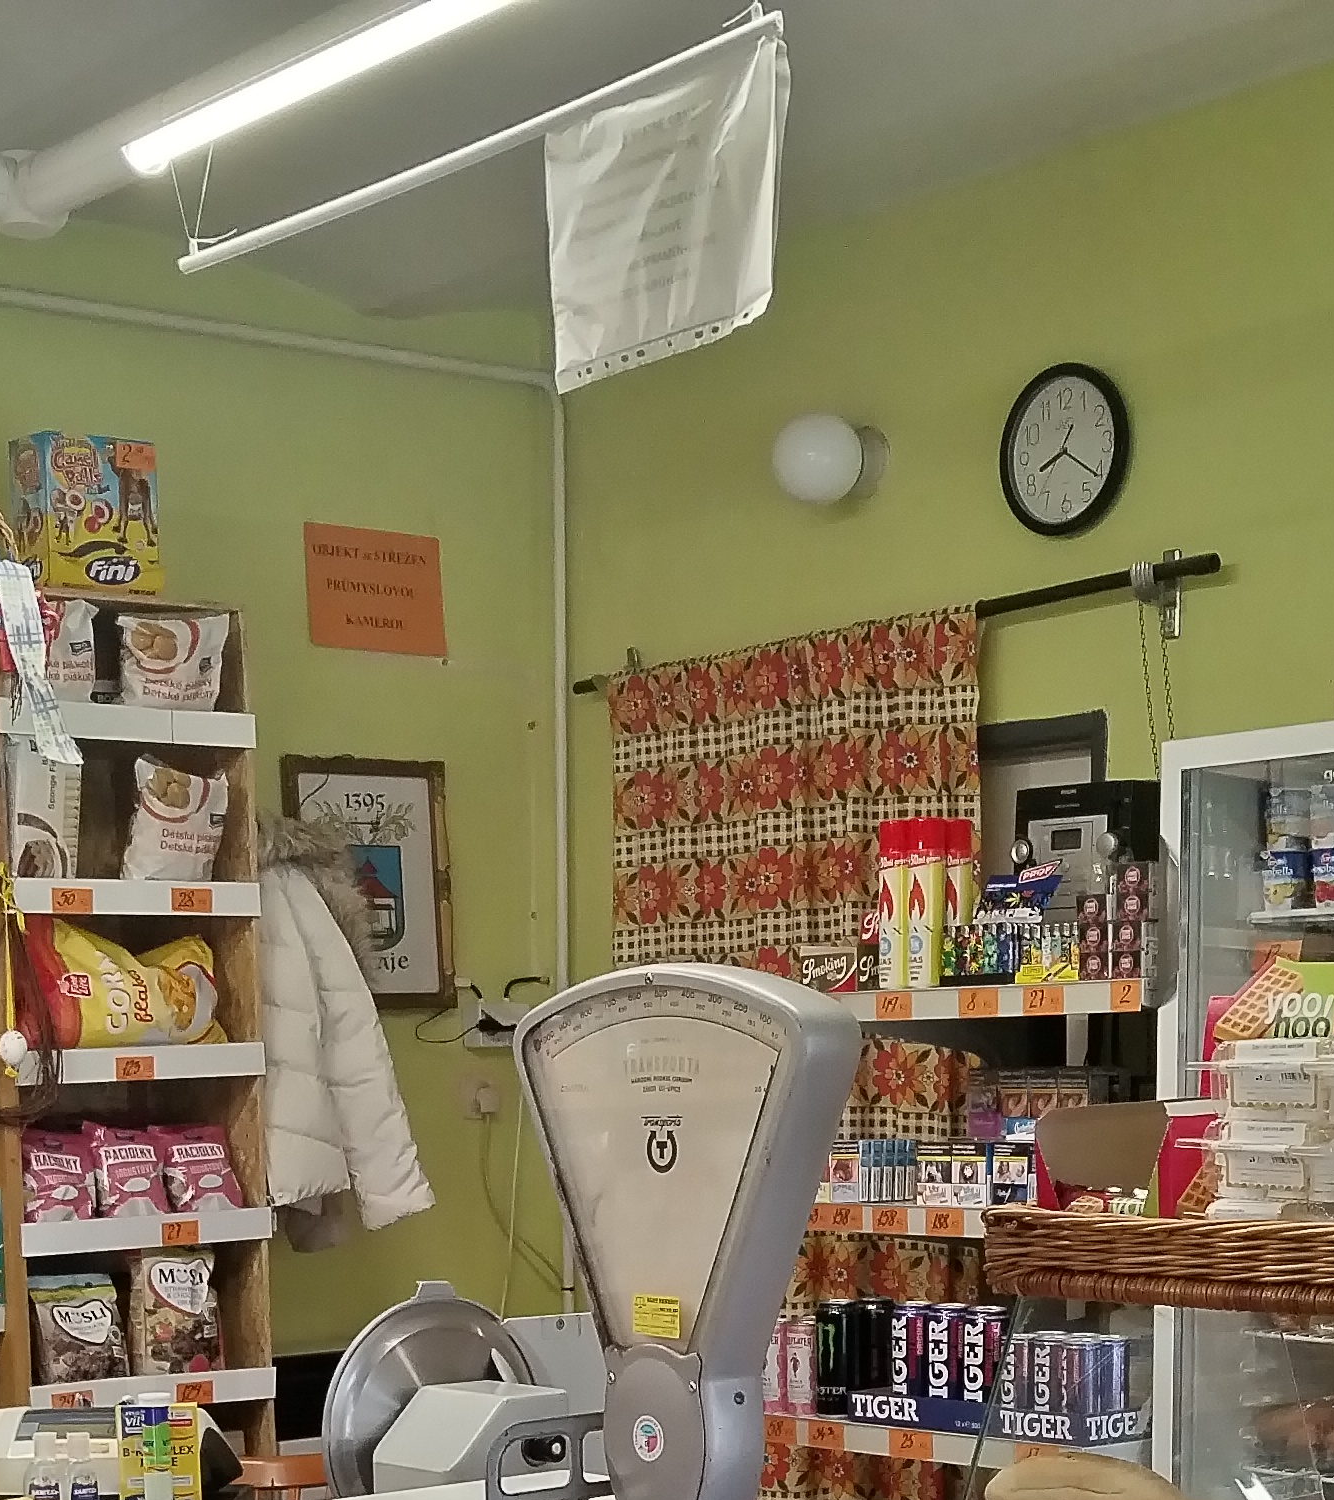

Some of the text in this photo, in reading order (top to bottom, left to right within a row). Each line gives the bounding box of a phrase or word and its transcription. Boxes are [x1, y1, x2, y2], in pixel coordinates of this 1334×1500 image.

[1057, 387, 1073, 411] 12
[1041, 400, 1051, 422] 11
[1094, 405, 1105, 427] 2
[1025, 423, 1040, 446] 10
[1102, 431, 1112, 453] 3
[1027, 474, 1036, 496] 8
[1081, 482, 1092, 503] 5
[1061, 494, 1072, 513] 6
[312, 543, 360, 559] OBJEKT
[851, 1393, 919, 1422] TIGER
[999, 1410, 1073, 1441] TIGER
